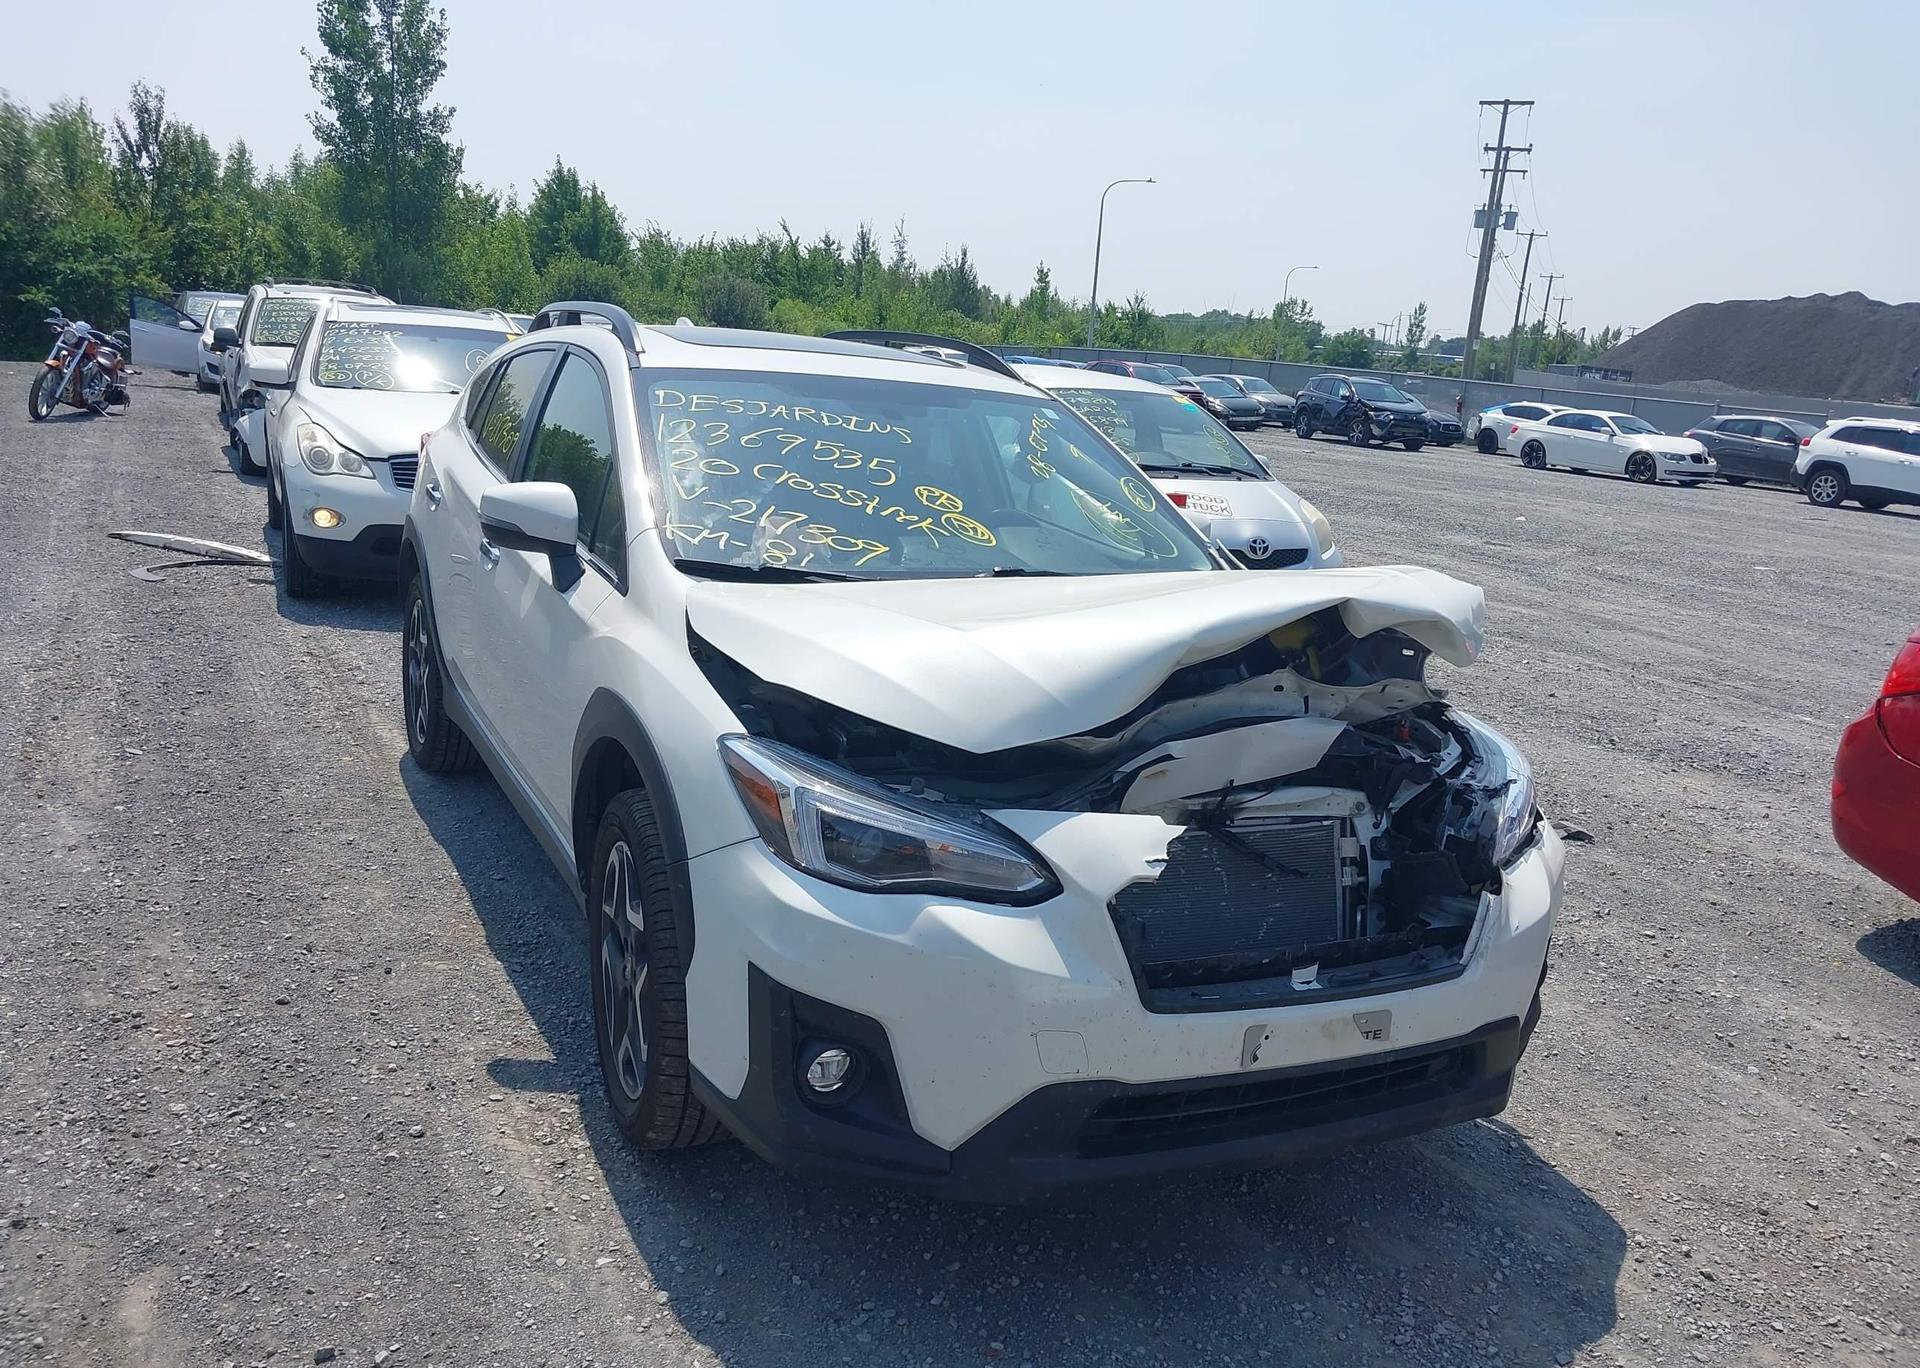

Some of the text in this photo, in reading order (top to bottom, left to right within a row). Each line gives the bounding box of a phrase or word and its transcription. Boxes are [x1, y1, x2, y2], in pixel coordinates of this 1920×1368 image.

[653, 389, 912, 445] DESJARDINS
[671, 448, 741, 476] 20
[1187, 494, 1224, 504] OOD
[1361, 1029, 1382, 1040] TE
